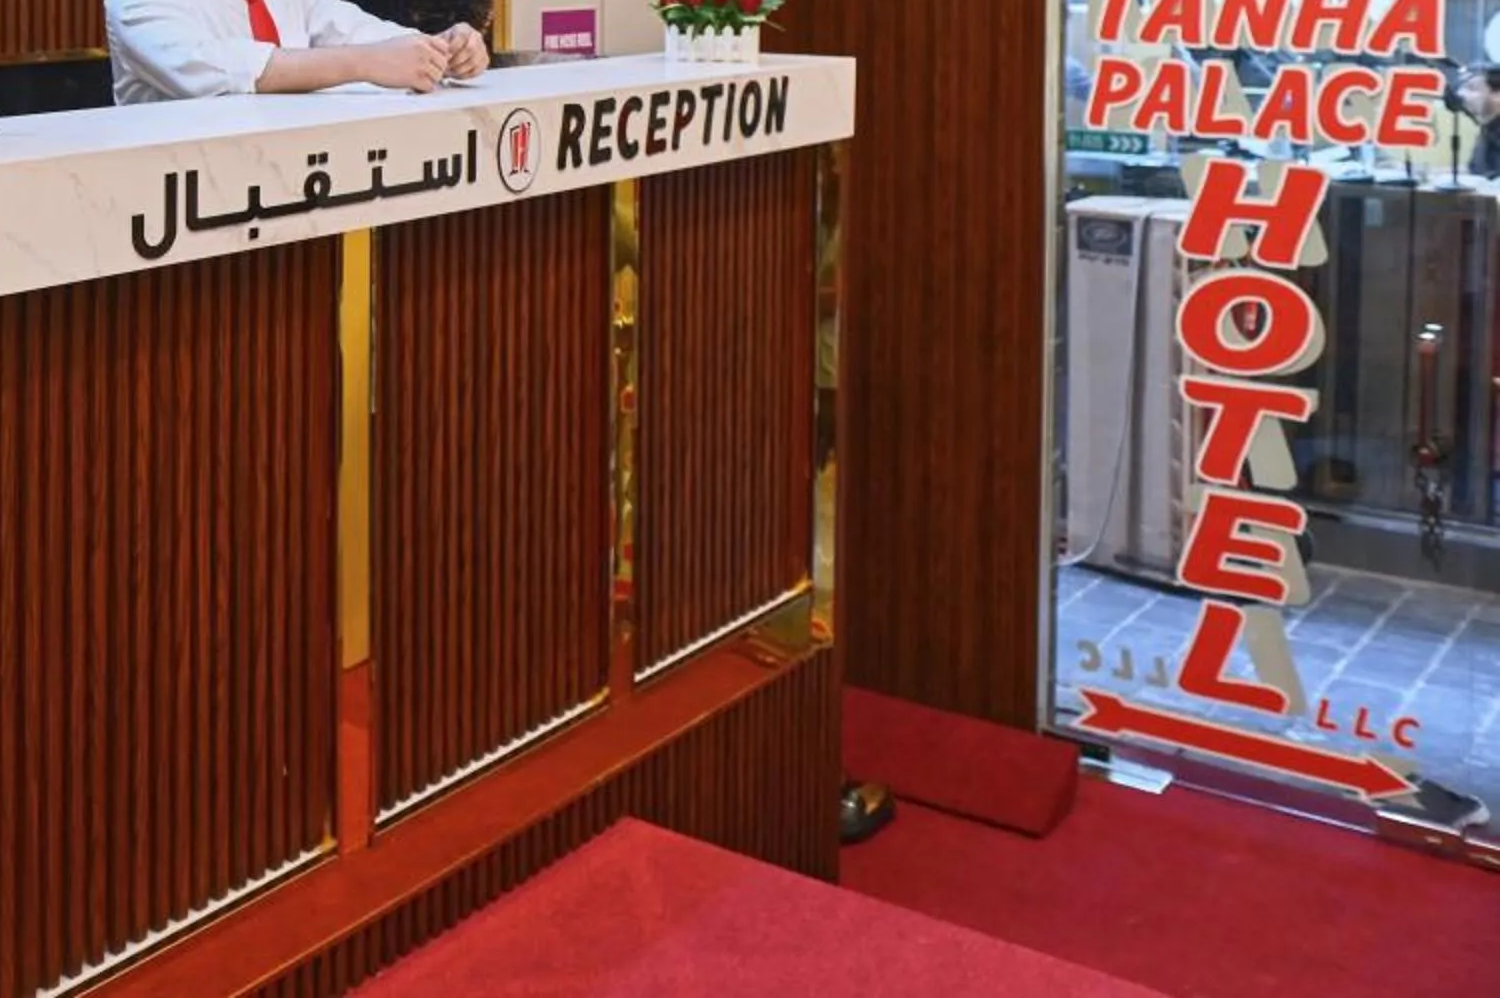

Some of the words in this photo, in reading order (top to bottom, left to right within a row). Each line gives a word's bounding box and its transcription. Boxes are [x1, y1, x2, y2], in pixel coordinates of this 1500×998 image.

[557, 75, 789, 171] RECEPTION
[1084, 57, 1446, 149] PALACE
[131, 130, 477, 260] استقبال
[1177, 157, 1328, 716] HOTEL
[1315, 697, 1422, 750] LLC
